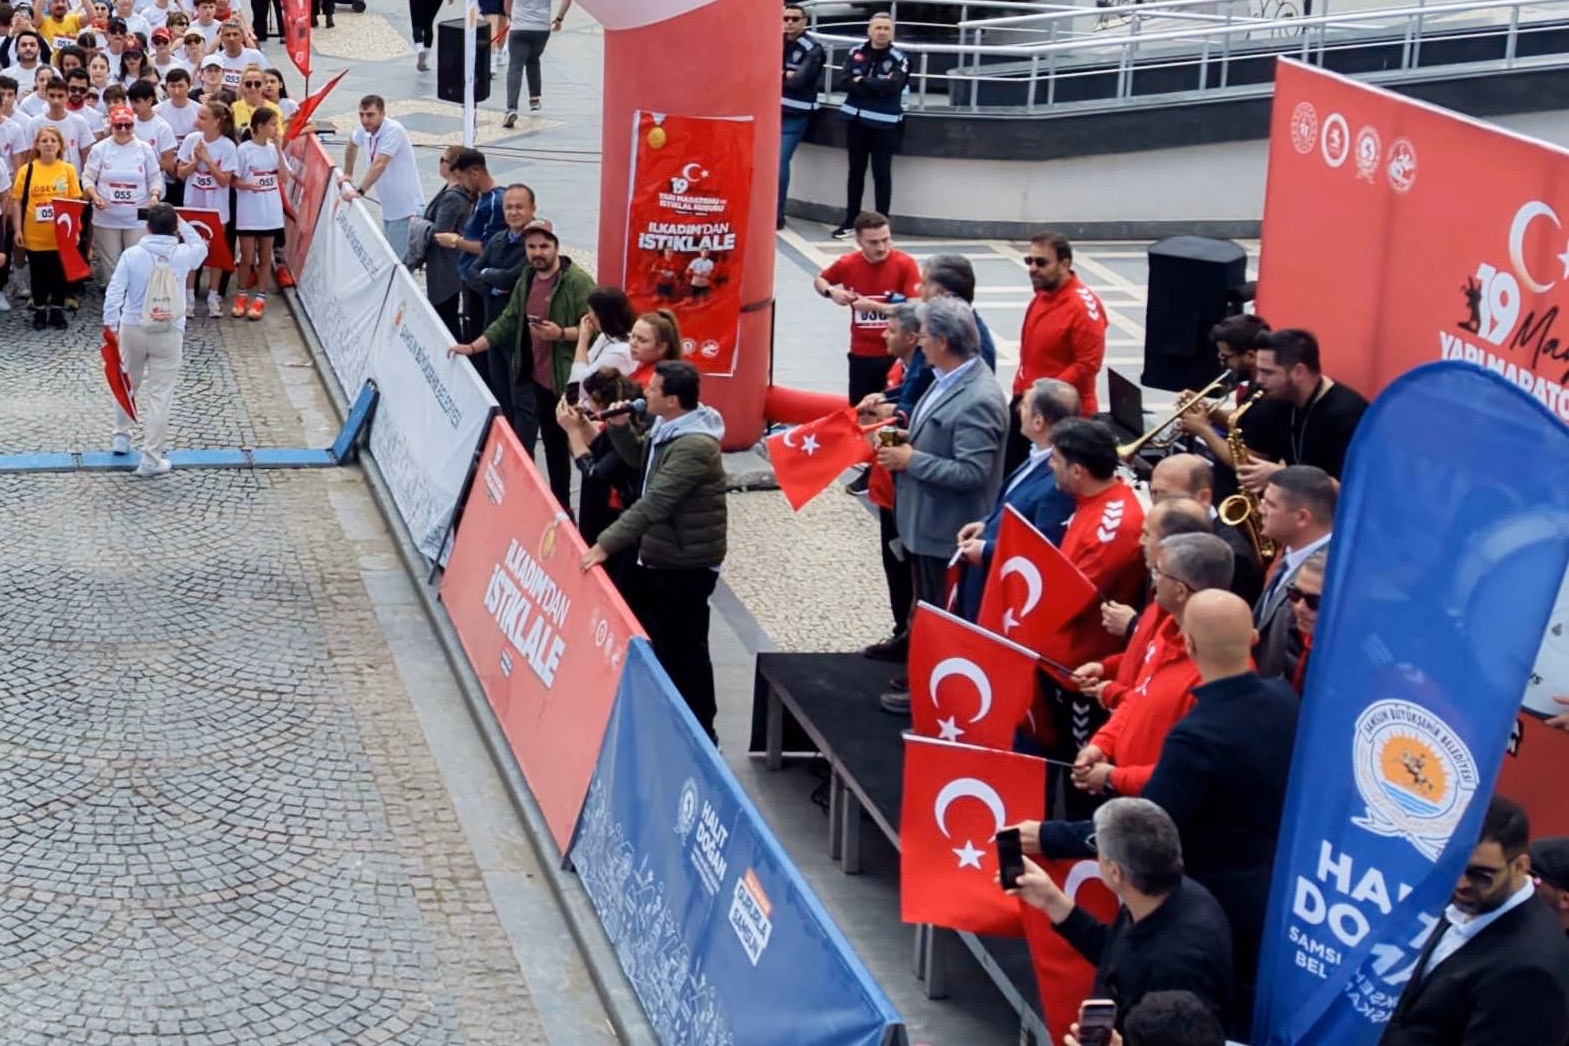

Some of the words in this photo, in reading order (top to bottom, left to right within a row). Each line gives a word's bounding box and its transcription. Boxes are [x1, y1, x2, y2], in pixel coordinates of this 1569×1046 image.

[114, 190, 132, 201] 055
[1474, 262, 1521, 347] 19
[1363, 709, 1390, 735] SAMSUN
[1439, 733, 1473, 783] BELEDİYESİ
[1295, 950, 1328, 980] BEL
